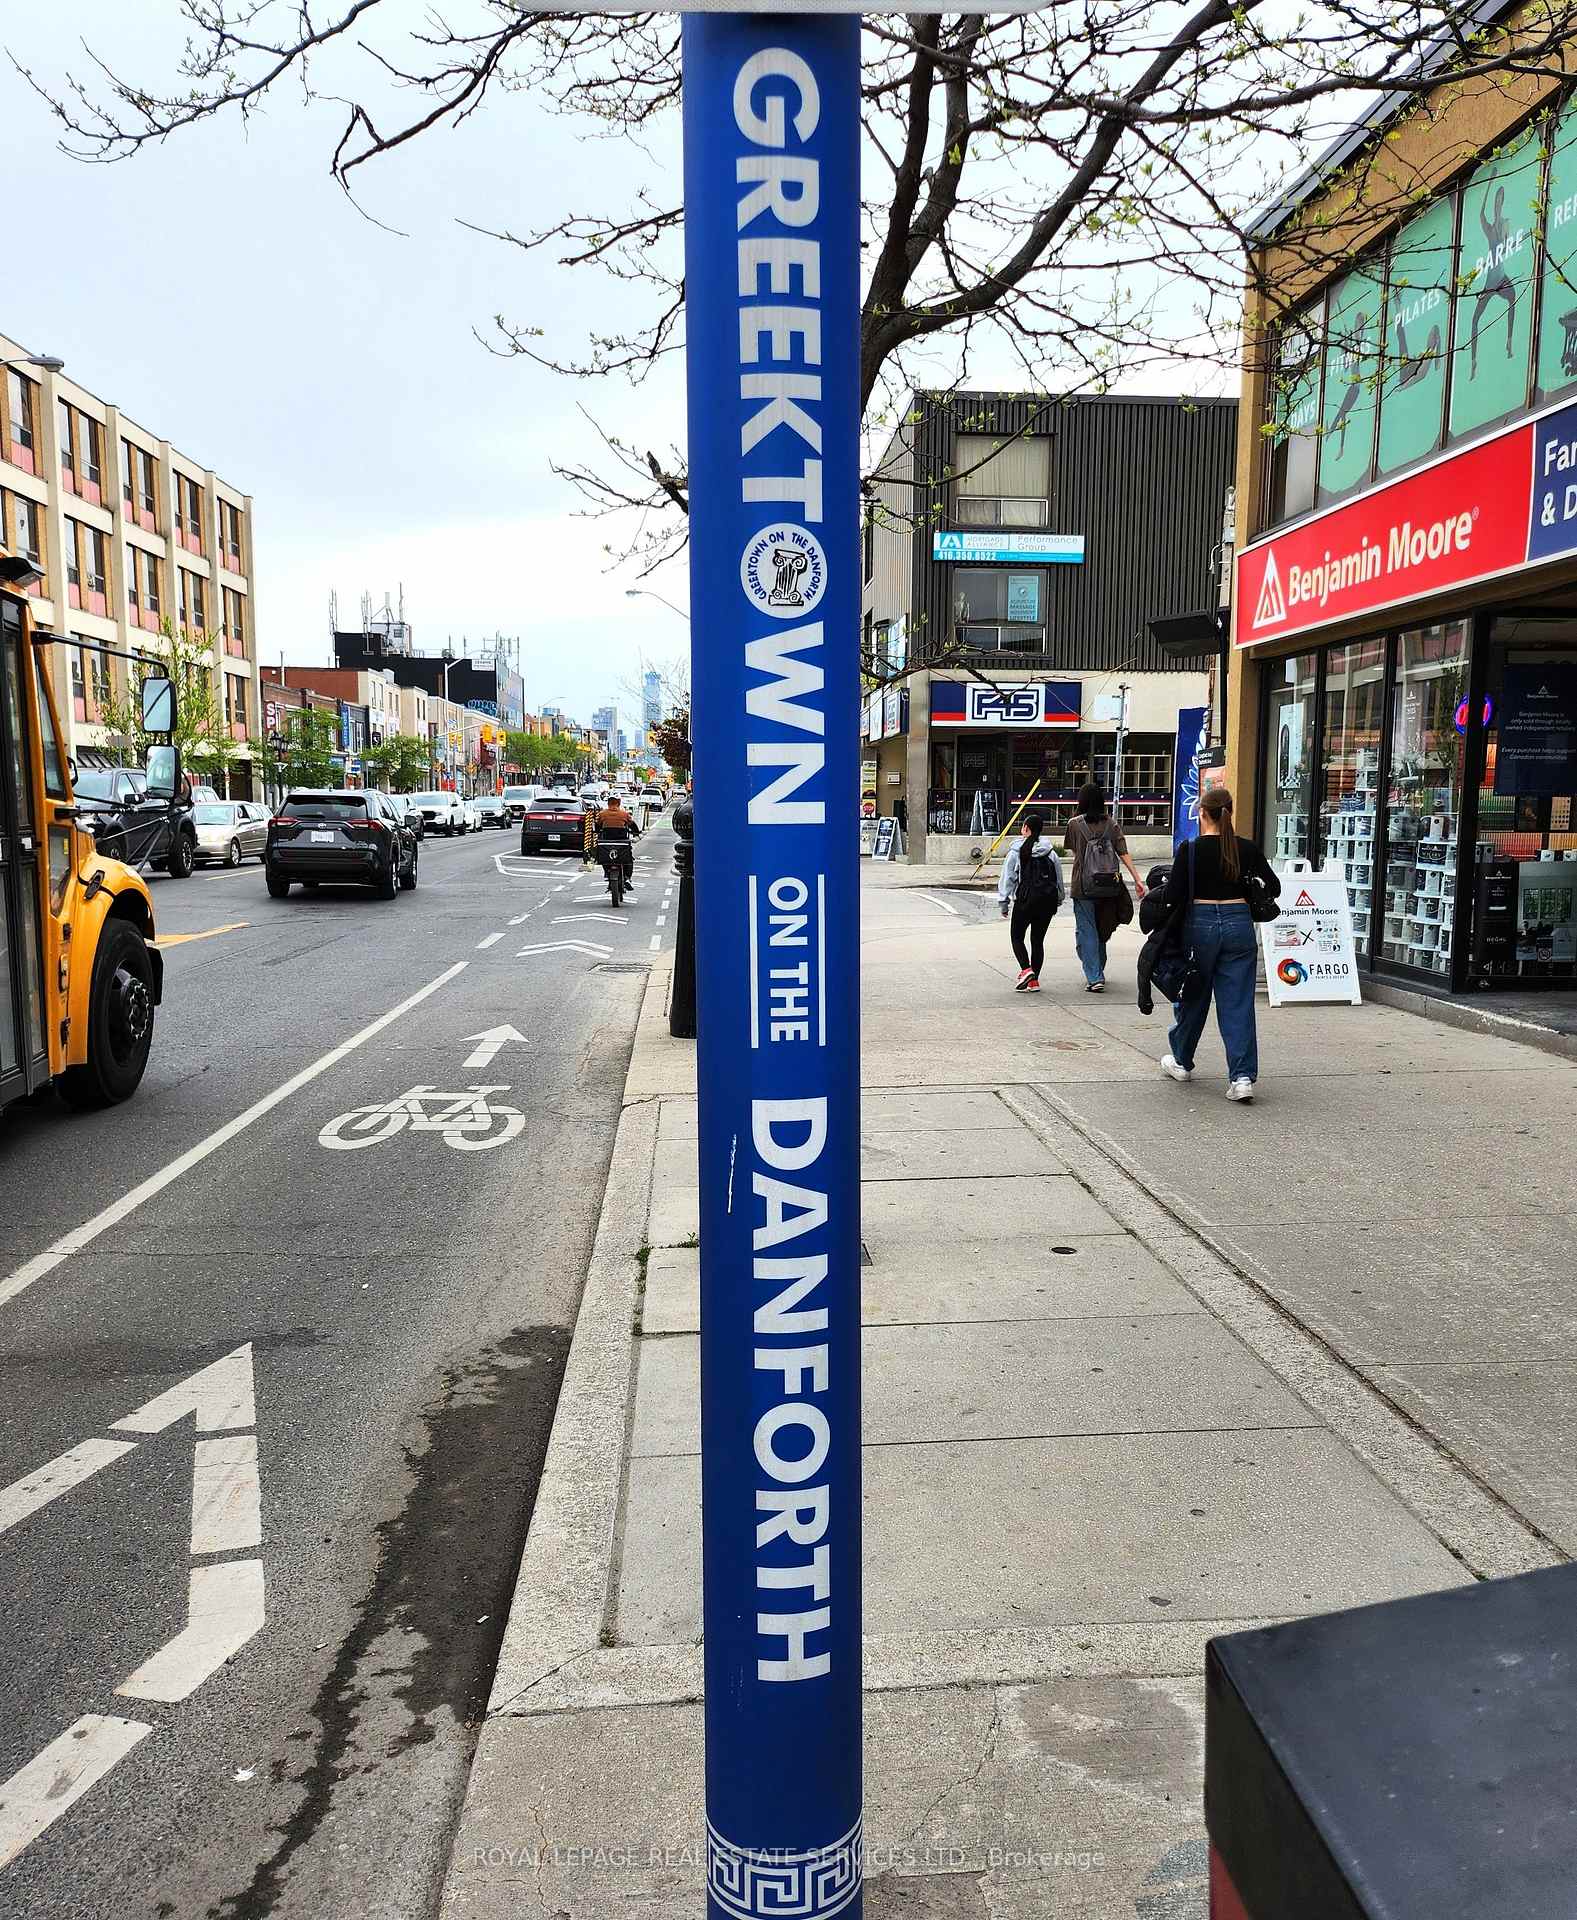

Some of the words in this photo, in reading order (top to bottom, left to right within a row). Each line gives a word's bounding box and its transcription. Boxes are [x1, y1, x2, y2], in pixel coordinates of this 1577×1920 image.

[1475, 229, 1525, 280] BARRE
[1394, 289, 1441, 332] PILATES
[1541, 492, 1556, 527] &
[1017, 535, 1078, 545] Performance
[1017, 544, 1047, 552] Group
[1289, 536, 1381, 608] Benjamin
[1387, 511, 1472, 573] Moore
[748, 539, 769, 599] GREEKTOWN
[769, 531, 785, 543] ON
[792, 532, 809, 549] THE
[803, 546, 821, 601] DANFORTH
[972, 689, 1039, 721] F45
[768, 877, 808, 946] ON
[1280, 908, 1310, 917] njamin
[1309, 963, 1349, 975] FARGO
[770, 962, 808, 1042] THE
[751, 1097, 832, 1682] DANFORTH
